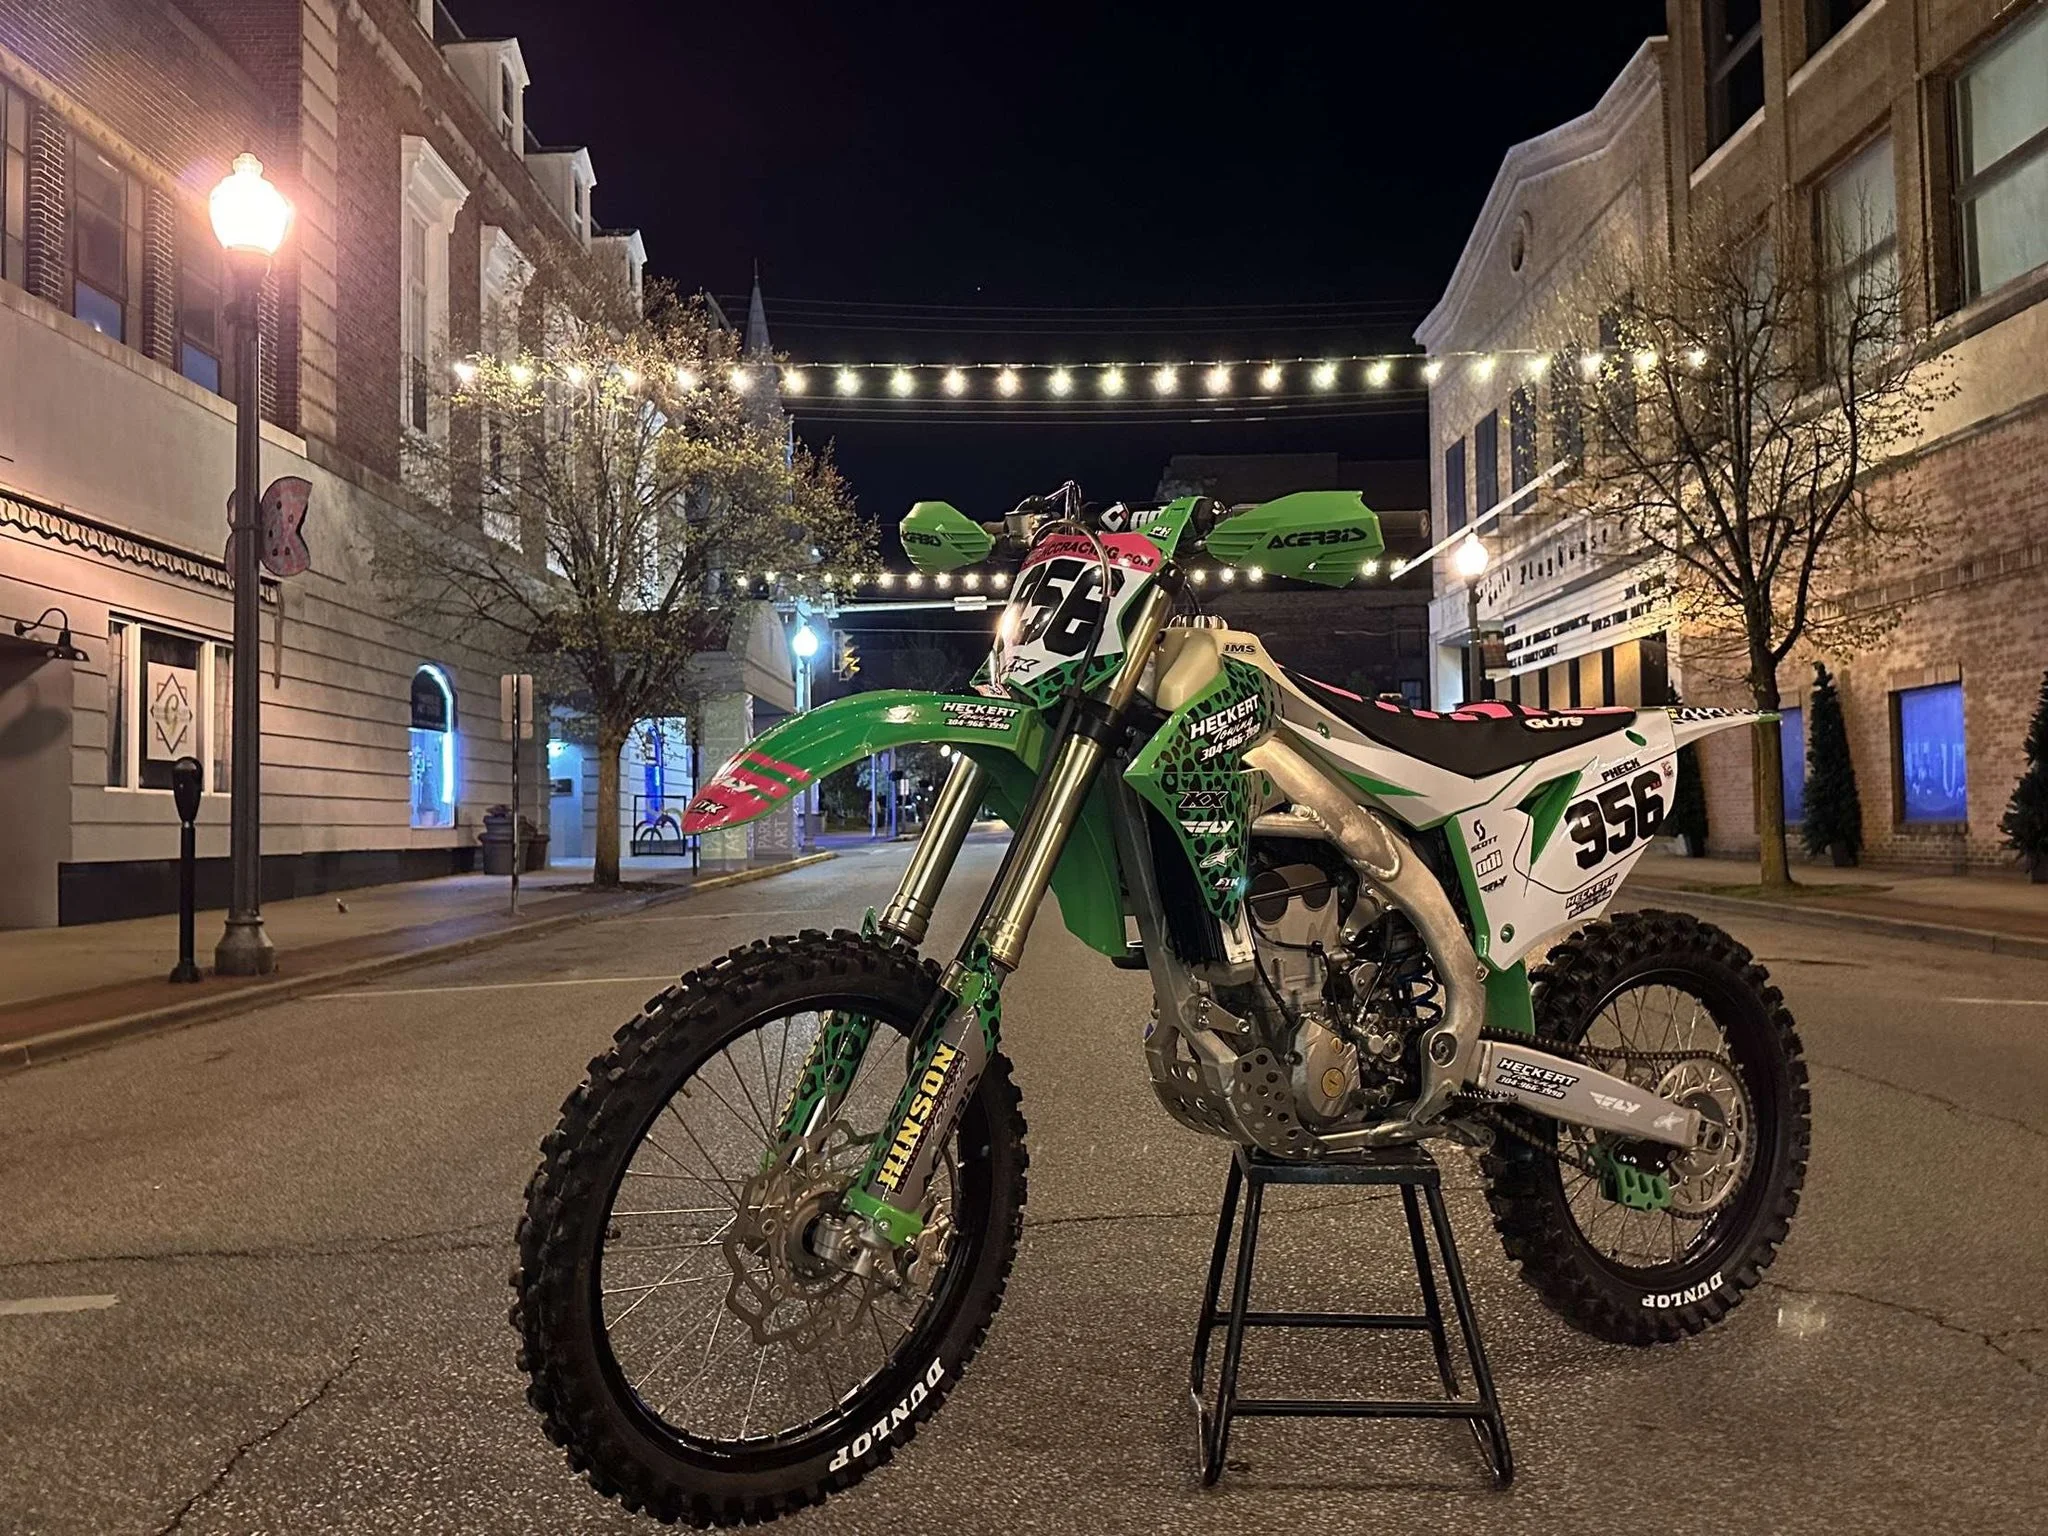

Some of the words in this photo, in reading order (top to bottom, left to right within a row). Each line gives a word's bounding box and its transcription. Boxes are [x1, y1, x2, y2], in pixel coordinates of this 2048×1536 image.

[1266, 527, 1367, 550] ACERBIS
[1224, 644, 1256, 653] IMS
[942, 702, 1019, 717] HECKERT
[1190, 694, 1259, 740] HECKERT
[1211, 716, 1254, 743] Towing
[1525, 716, 1584, 729] GUTS
[1601, 757, 1640, 781] PHECK
[1178, 791, 1229, 809] KX
[1180, 820, 1234, 833] FLY
[1563, 769, 1664, 870] 956
[1471, 835, 1498, 853] SCOTT
[1476, 850, 1503, 877] odi
[1480, 875, 1508, 893] FLY
[1566, 873, 1618, 909] HECKERT
[1499, 1059, 1578, 1087] HECKERT
[1590, 1091, 1642, 1115] FLY
[877, 1042, 957, 1193] HINSON
[1642, 1271, 1724, 1308] DUNLOP
[829, 1356, 945, 1472] DUNLOP
